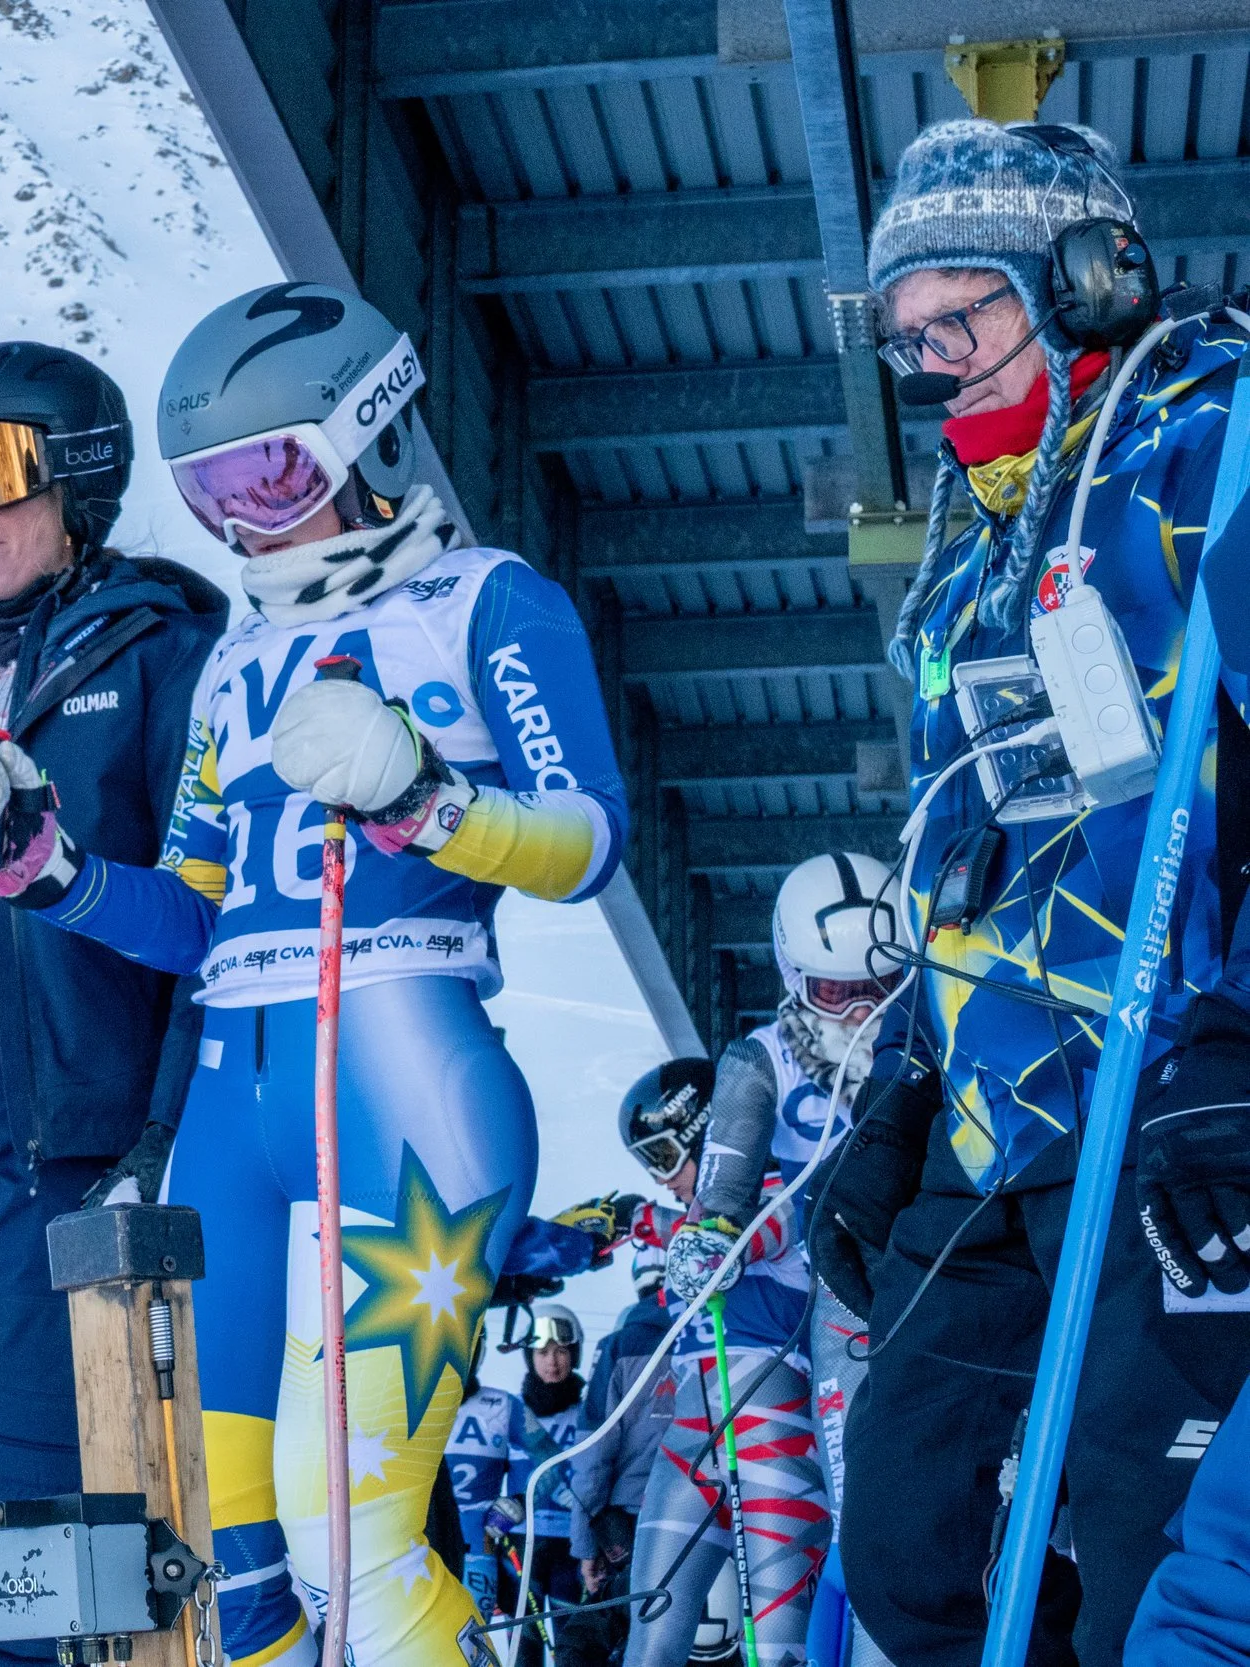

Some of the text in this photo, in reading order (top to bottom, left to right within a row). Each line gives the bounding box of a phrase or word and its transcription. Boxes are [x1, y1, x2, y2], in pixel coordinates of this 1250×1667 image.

[331, 356, 354, 383] Sweet
[339, 351, 372, 392] Protection
[179, 392, 211, 413] AUS
[356, 347, 417, 427] OAKLEY
[65, 441, 114, 465] bollé
[62, 690, 119, 716] COLMAR
[224, 793, 357, 905] 16
[220, 955, 238, 974] CVA
[280, 945, 315, 960] CVA
[341, 934, 464, 964] SIVA CVA ASIVA
[663, 1083, 698, 1117] uvex
[1140, 1204, 1194, 1290] ROSSIGNOL
[730, 1484, 750, 1610] KOMPERDELL
